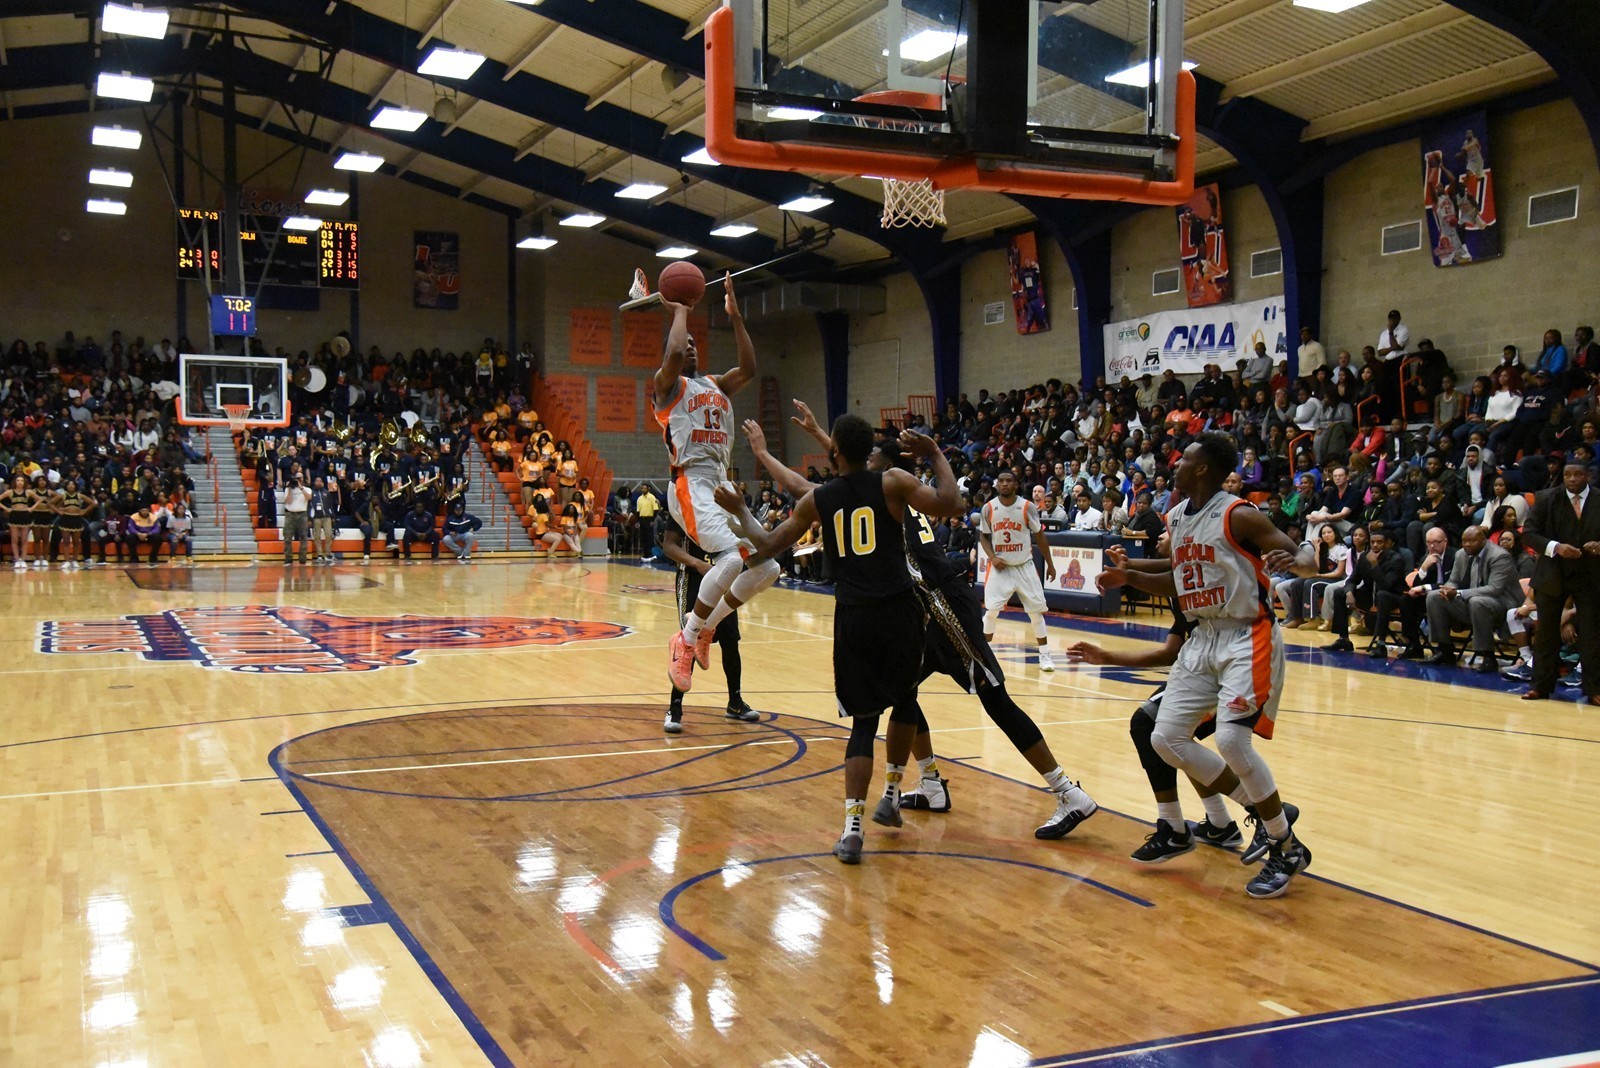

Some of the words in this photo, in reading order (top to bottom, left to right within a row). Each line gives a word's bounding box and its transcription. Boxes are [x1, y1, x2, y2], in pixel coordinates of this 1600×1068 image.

[335, 222, 344, 230] FL
[344, 223, 358, 232] PTS
[287, 236, 308, 244] BOWIE
[321, 230, 334, 240] 03
[350, 232, 357, 241] 6
[321, 240, 334, 248] 04
[350, 242, 357, 250] 2
[180, 248, 192, 257] 21
[196, 249, 202, 258] 3
[211, 250, 218, 260] 0
[324, 250, 334, 258] 10
[337, 250, 342, 259] 3
[348, 252, 357, 260] 11
[180, 258, 193, 268] 24
[211, 260, 218, 269] 9
[322, 258, 334, 268] 22
[337, 260, 342, 268] 3
[348, 260, 357, 269] 15
[322, 268, 334, 278] 31
[336, 269, 343, 278] 2
[348, 270, 357, 279] 10
[224, 298, 252, 312] 7:02
[230, 312, 246, 331] 11
[1162, 322, 1236, 358] CIAA
[704, 408, 720, 430] 13
[907, 504, 935, 544] 3
[833, 506, 876, 558] 10
[1003, 531, 1011, 543] 3
[1183, 564, 1204, 590] 21
